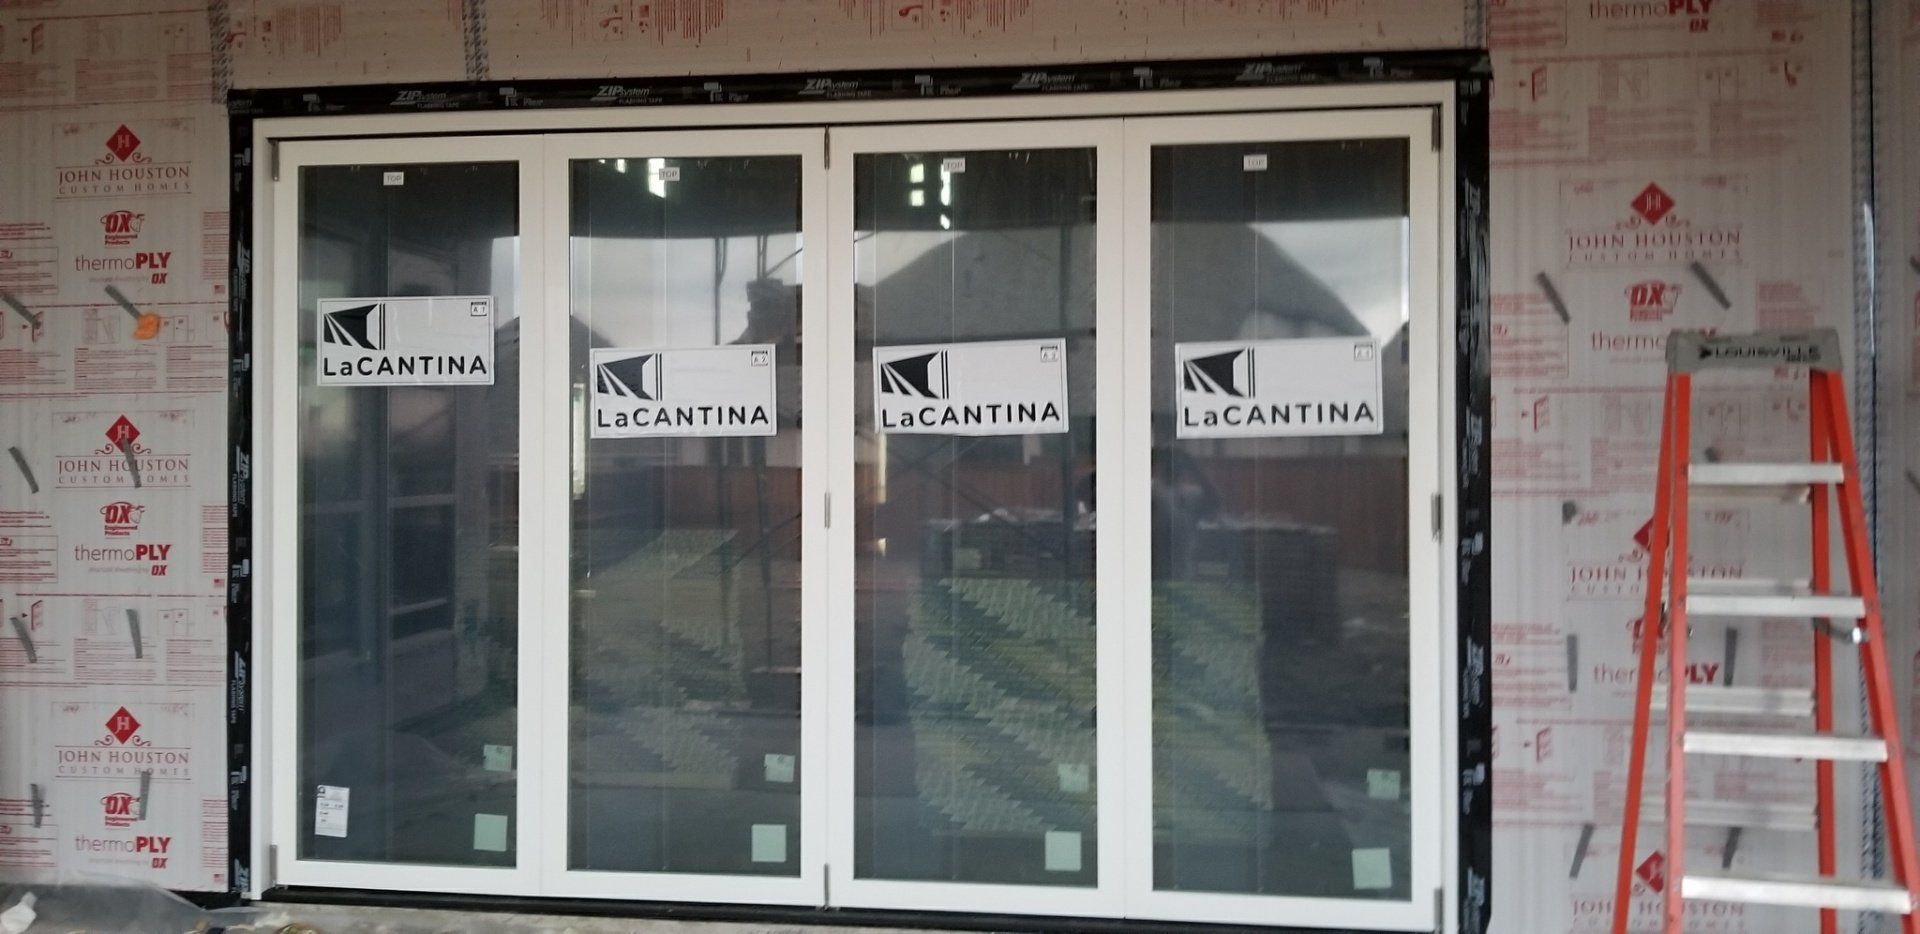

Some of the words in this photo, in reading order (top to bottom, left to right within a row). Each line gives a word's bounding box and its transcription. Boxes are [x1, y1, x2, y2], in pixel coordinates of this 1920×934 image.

[59, 169, 102, 185] JOHN
[109, 166, 190, 181] HOUSTON
[59, 185, 124, 194] CUSTOM
[134, 182, 190, 192] HOMES
[105, 213, 132, 233] OX
[1569, 234, 1625, 251] JOHN
[1635, 231, 1740, 248] HOUSTON
[75, 252, 171, 272] thermoPLY
[151, 273, 168, 284] OX
[1630, 283, 1666, 306] OX
[323, 355, 488, 377] LaCANTINA
[597, 405, 770, 428] LaCANTINA
[882, 402, 1061, 428] LaCANTINA
[1184, 402, 1375, 427] LaCANTINA
[59, 460, 101, 475] JOHN
[59, 476, 124, 484] CUSTOM
[104, 505, 132, 524] OX
[75, 544, 172, 561] thermoPLY
[151, 565, 168, 576] OX
[58, 750, 101, 764] JOHN
[109, 751, 190, 764] HOUSTON
[58, 765, 124, 774] CUSTOM
[105, 796, 132, 815] OX
[75, 834, 172, 854] thermoPLY
[152, 857, 168, 869] OX
